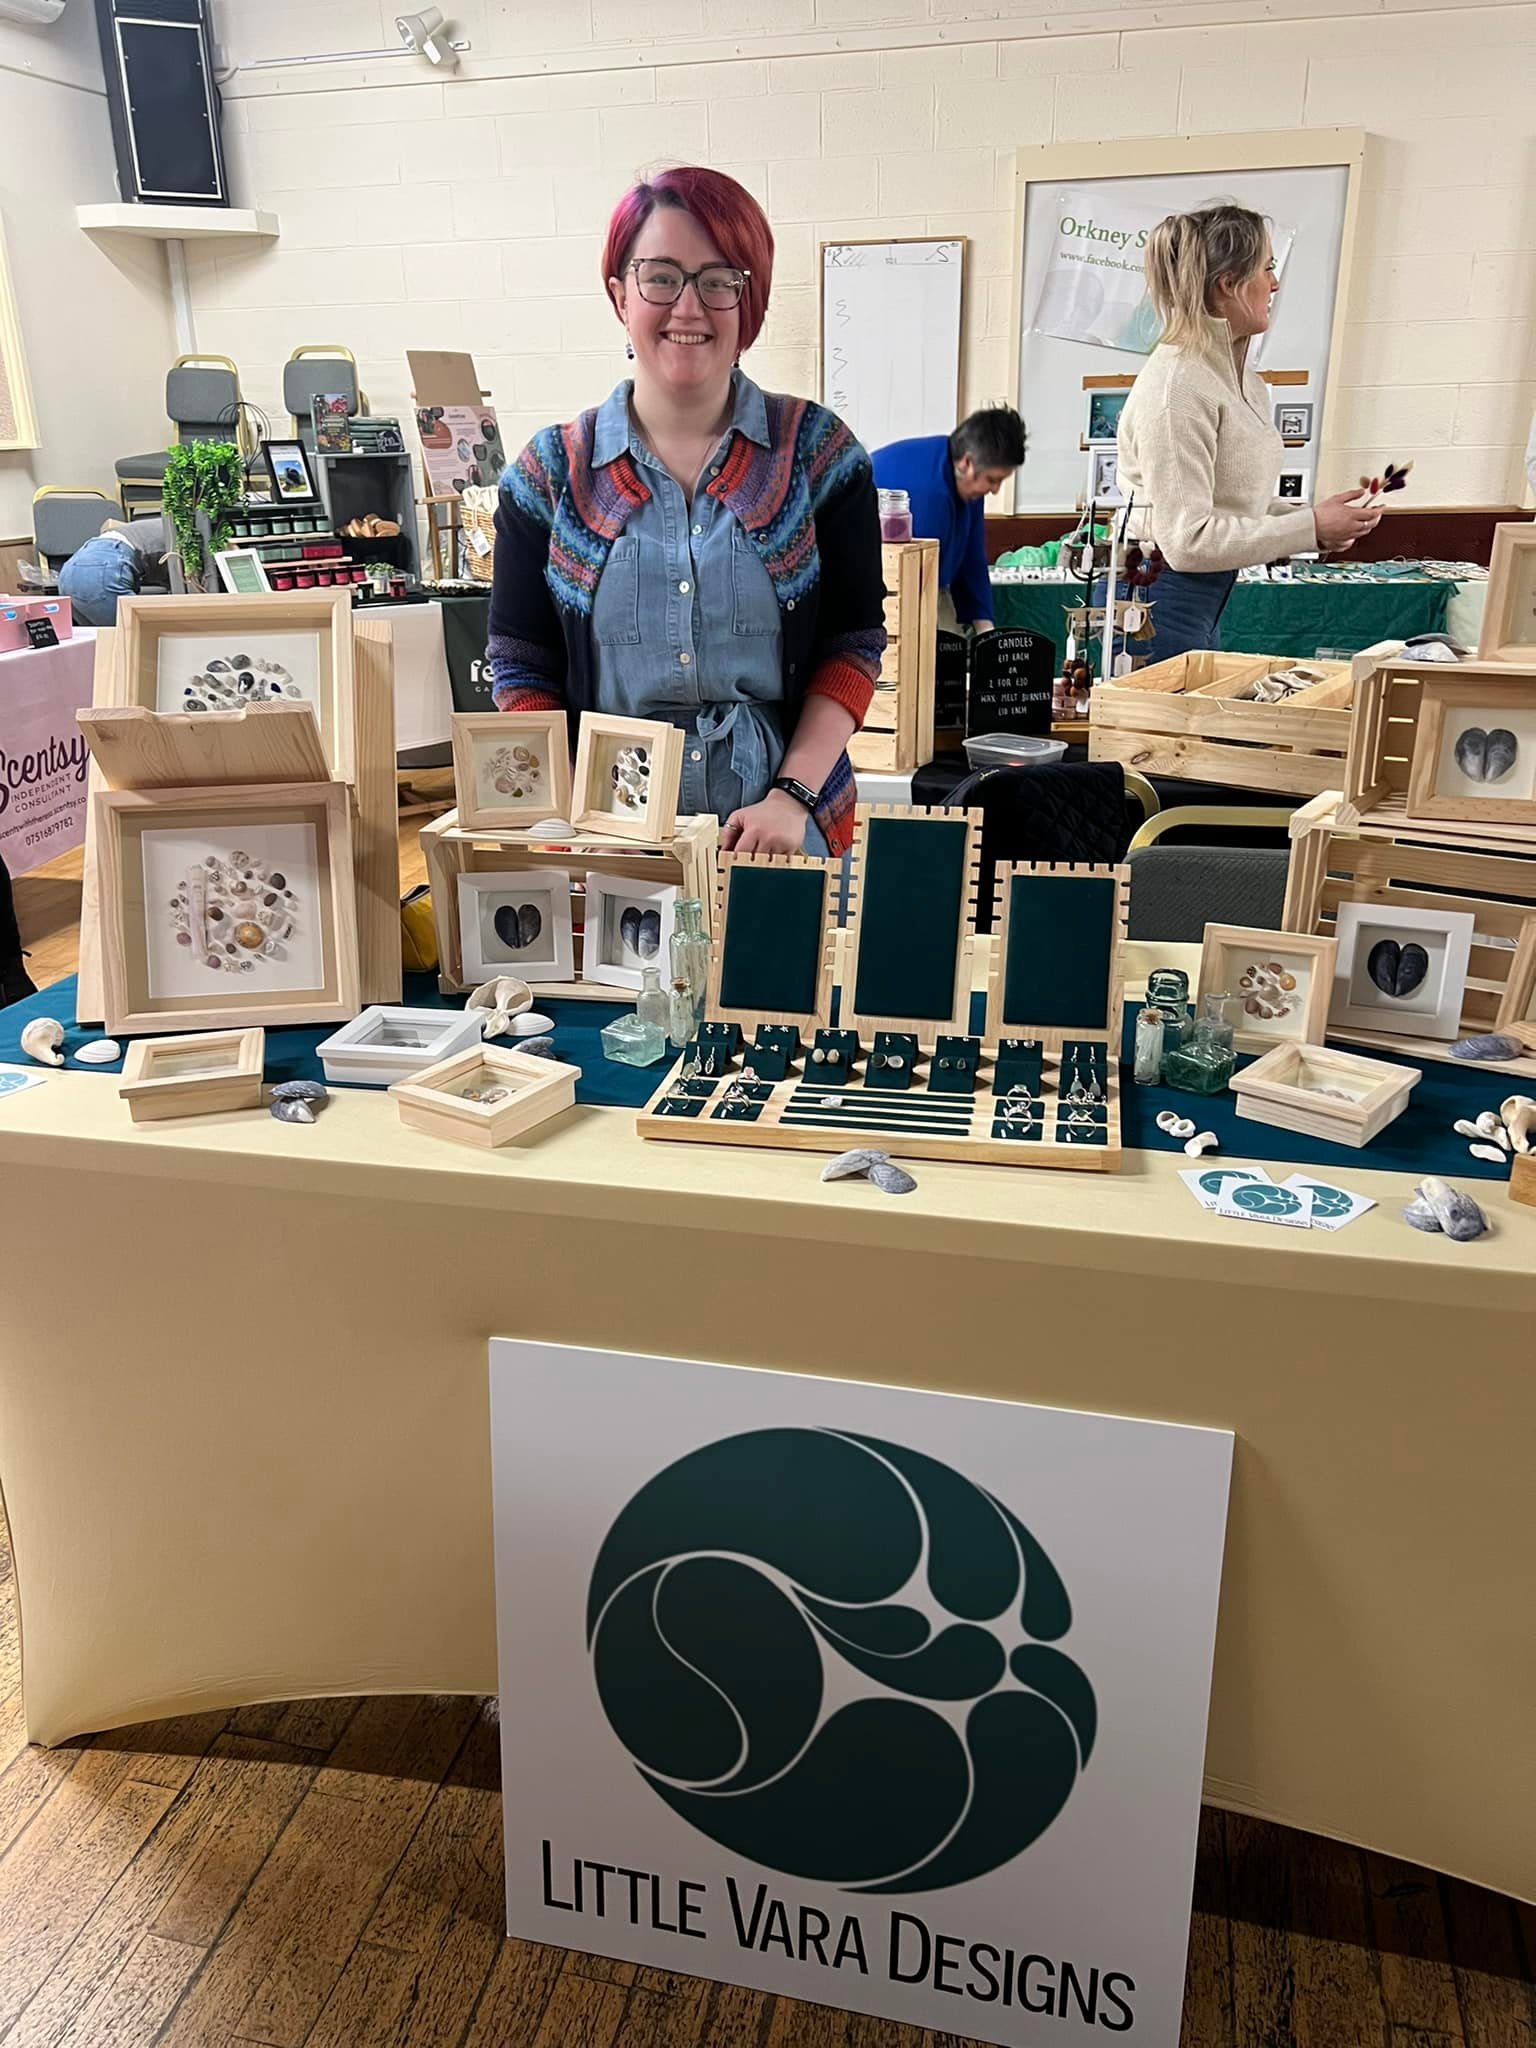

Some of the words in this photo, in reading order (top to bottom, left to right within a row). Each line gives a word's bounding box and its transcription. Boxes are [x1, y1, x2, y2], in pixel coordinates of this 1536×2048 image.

[1060, 216, 1132, 250] Orkney
[1135, 229, 1148, 248] S
[998, 636, 1033, 649] CANDLES
[998, 678, 1012, 687] FOR
[11, 772, 71, 803] INDEPENDENT
[15, 784, 71, 813] CONSULTANT
[542, 1839, 707, 1939] LITTLE
[726, 1876, 869, 1975] VARA
[889, 1910, 1136, 2032] DESIGNS
